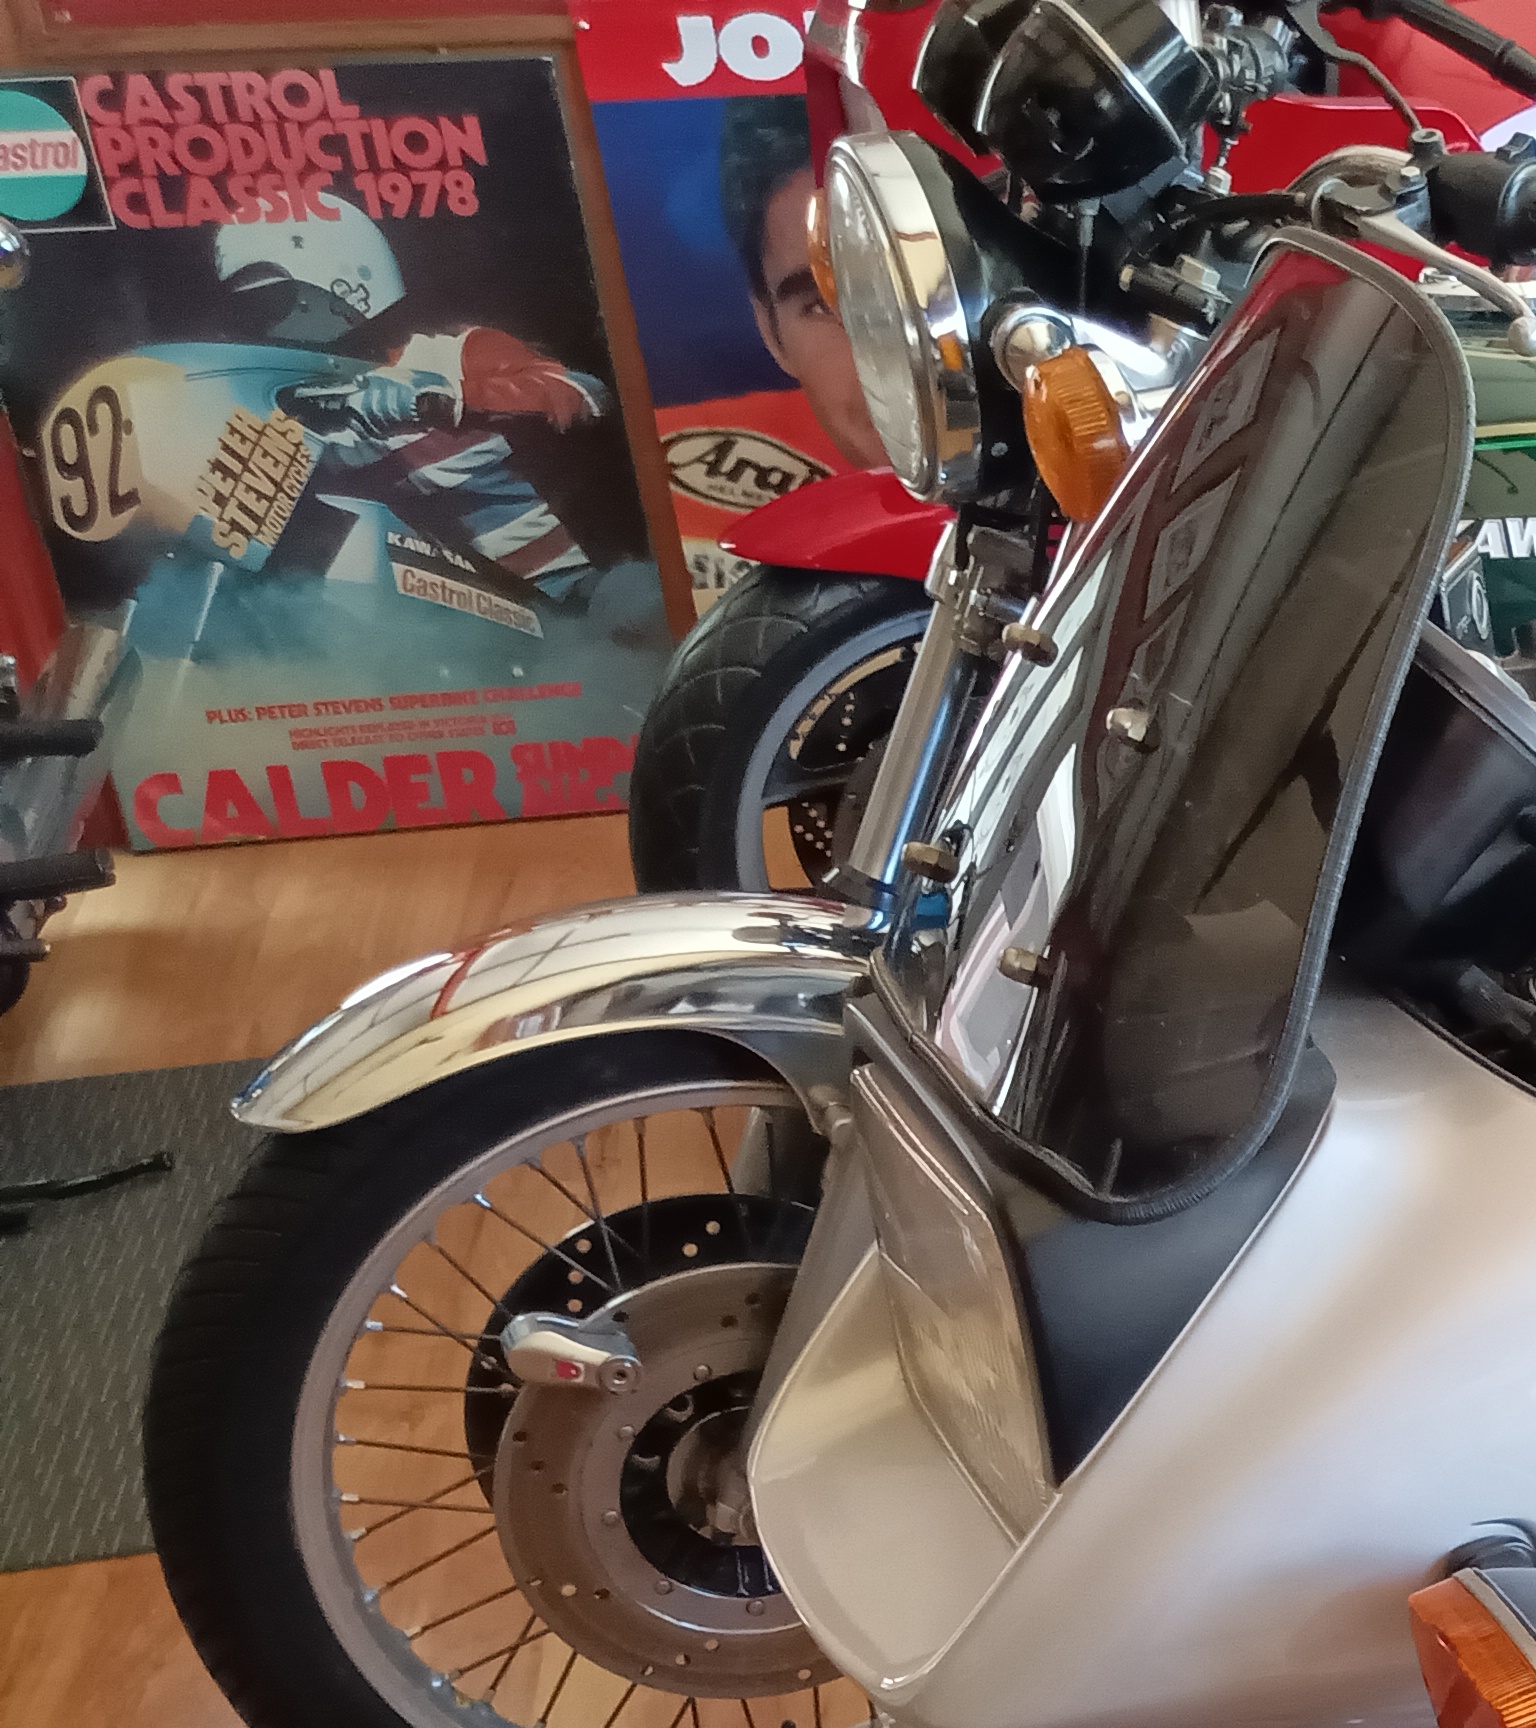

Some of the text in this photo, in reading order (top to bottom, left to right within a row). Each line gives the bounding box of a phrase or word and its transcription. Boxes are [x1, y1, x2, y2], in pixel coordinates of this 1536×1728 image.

[661, 10, 815, 87] JO
[80, 69, 360, 126] CASTROL
[94, 114, 488, 178] PRODUCTION
[107, 168, 479, 230] CLASSIC 1978
[51, 385, 141, 533] 92
[197, 406, 266, 518] PETER
[209, 407, 305, 558] STEVENS
[402, 568, 474, 611] Castrol
[256, 704, 309, 721] PETER
[313, 698, 385, 717] STEVENS
[132, 750, 508, 848] CALDER
